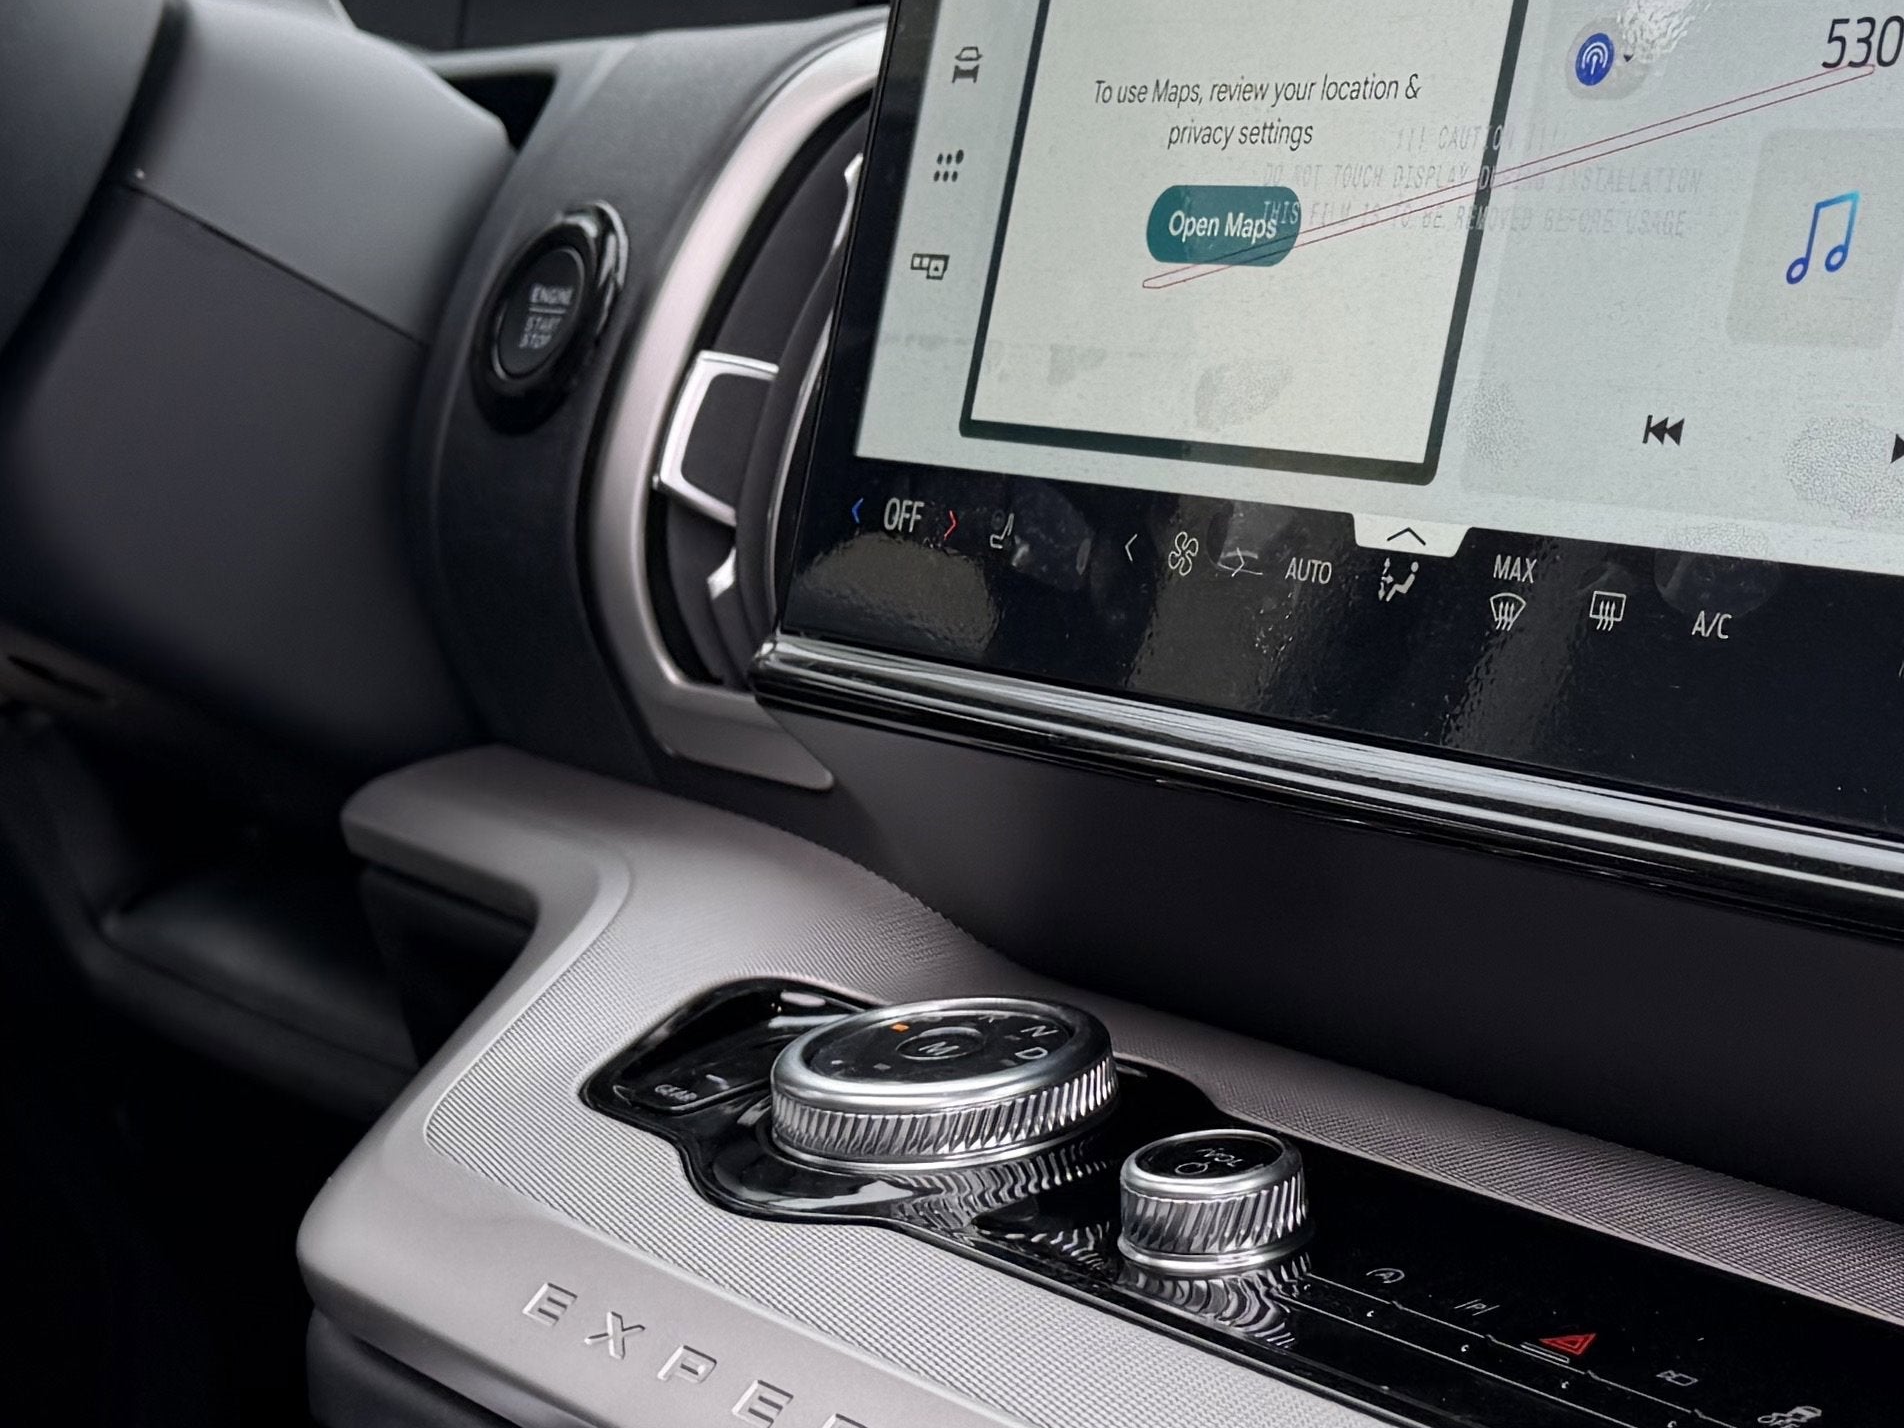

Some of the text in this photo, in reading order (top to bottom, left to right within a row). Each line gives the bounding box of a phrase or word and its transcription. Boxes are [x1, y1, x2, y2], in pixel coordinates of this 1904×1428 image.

[1821, 15, 1904, 68] 530
[1095, 73, 1421, 108] To use Maps, review your location &
[1168, 118, 1314, 152] privacy settings
[1168, 210, 1278, 243] Open Maps
[1262, 199, 1302, 225] THIS
[883, 497, 925, 533] OFF
[1285, 557, 1332, 584] AUTO
[1493, 554, 1538, 584] MAX
[1691, 610, 1733, 639] A/C
